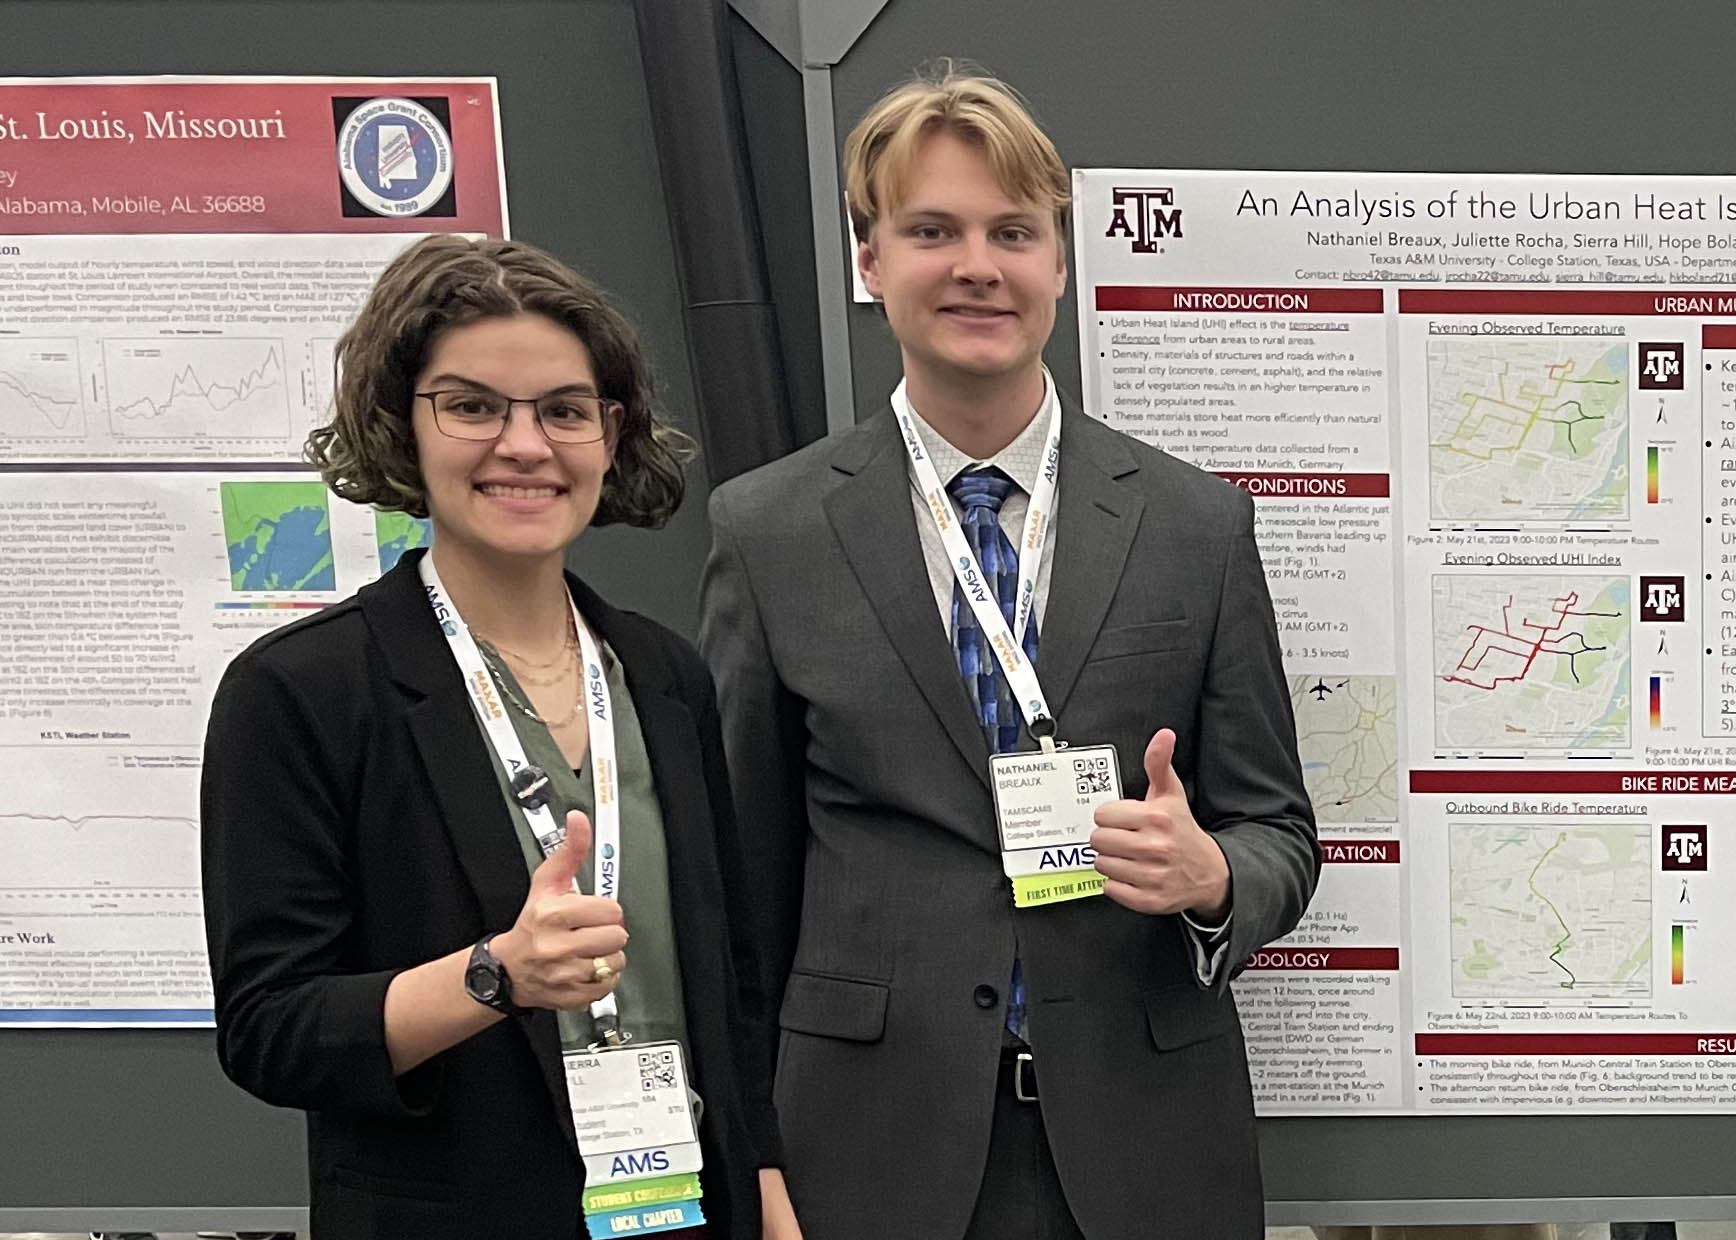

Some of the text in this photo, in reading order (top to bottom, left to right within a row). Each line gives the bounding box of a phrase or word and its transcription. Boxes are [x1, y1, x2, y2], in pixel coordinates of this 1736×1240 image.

[387, 102, 418, 117] Grant
[35, 110, 134, 144] Louis,
[142, 108, 285, 139] Missouri
[91, 195, 165, 215] Mobile,
[170, 195, 198, 213] AL
[202, 194, 265, 213] 36688
[1236, 189, 1277, 216] An
[1290, 188, 1415, 226] Analysis
[1427, 189, 1458, 218] of
[1467, 190, 1516, 219] the
[1529, 191, 1620, 220] Urban
[1634, 193, 1706, 220] Heat
[1307, 231, 1382, 246] Nathaniel
[1388, 231, 1446, 249] Breaux,
[1451, 231, 1510, 247] Juliette
[1515, 232, 1567, 249] Rocha,
[1573, 233, 1618, 248] Sierra
[1623, 233, 1653, 250] Hill,
[1658, 234, 1701, 251] Hope
[1369, 253, 1401, 264] Texas
[1404, 253, 1434, 265] A&M
[1438, 253, 1496, 268] University
[1507, 253, 1553, 269] College
[1556, 254, 1601, 267] Station,
[1604, 254, 1641, 268] Texas,
[1644, 255, 1670, 267] USA
[1173, 293, 1309, 311] INTRODUCTION
[1654, 297, 1713, 313] URBAN
[1428, 321, 1625, 336] Evening Observed Temperature
[1044, 449, 1058, 484] AMS
[1445, 551, 1621, 566] Evening Observed UHI Index
[964, 569, 988, 602] AMS
[588, 681, 608, 720] AMS
[997, 762, 1057, 776] NATHANIEL
[999, 777, 1042, 790] BREAUX
[1622, 776, 1657, 790] BIKE
[1662, 777, 1699, 792] RIDE
[1445, 801, 1647, 815] Outbound Bike Ride Temperature
[1039, 847, 1097, 870] AMS
[1026, 887, 1051, 901] FIRST
[17, 932, 55, 944] Work
[610, 1150, 670, 1178] AMS
